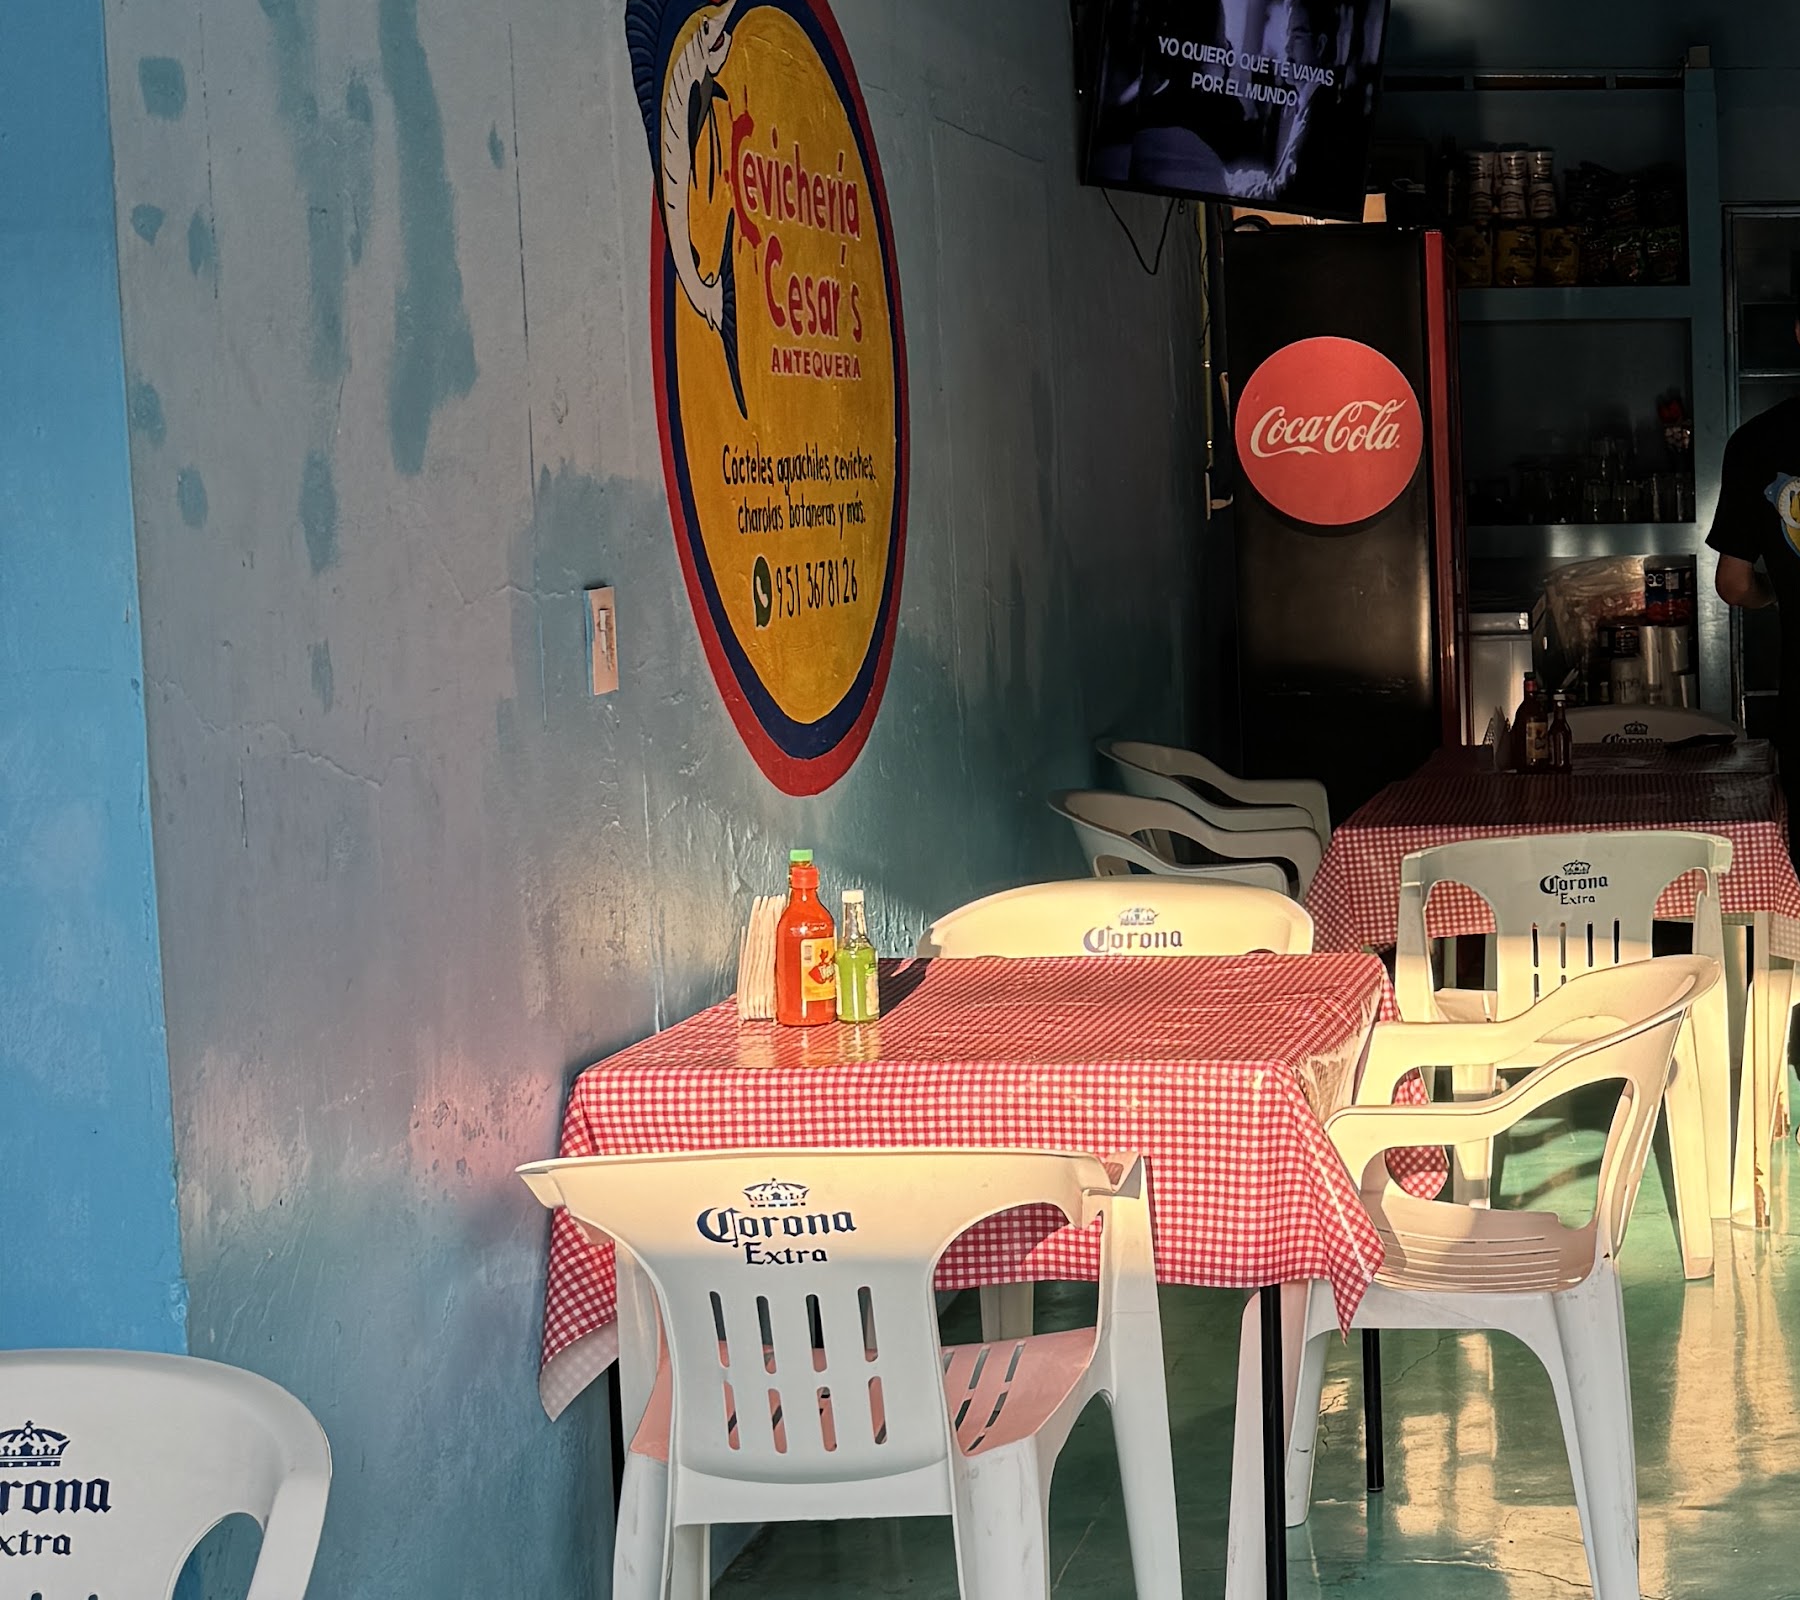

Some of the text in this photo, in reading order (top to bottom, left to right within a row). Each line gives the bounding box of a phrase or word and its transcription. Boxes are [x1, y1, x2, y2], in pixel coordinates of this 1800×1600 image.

[1158, 34, 1336, 88] YO QUIERO QUE TE VAYAS
[1191, 71, 1299, 107] POR EL MUNDO
[728, 108, 861, 250] Cevichería
[770, 346, 863, 380] ANTEQUERA
[1250, 399, 1409, 458] Coca-Cola
[776, 442, 832, 497] aguachiles,
[737, 496, 784, 535] charolas
[788, 492, 836, 529] botaneras
[838, 502, 845, 541] y
[1539, 875, 1609, 897] Corona
[1560, 892, 1596, 905] Extra
[1082, 925, 1183, 956] Corona
[696, 1207, 857, 1249] Corona
[742, 1241, 829, 1266] Extra
[0, 1477, 112, 1516] rona
[0, 1529, 72, 1557] xtra
